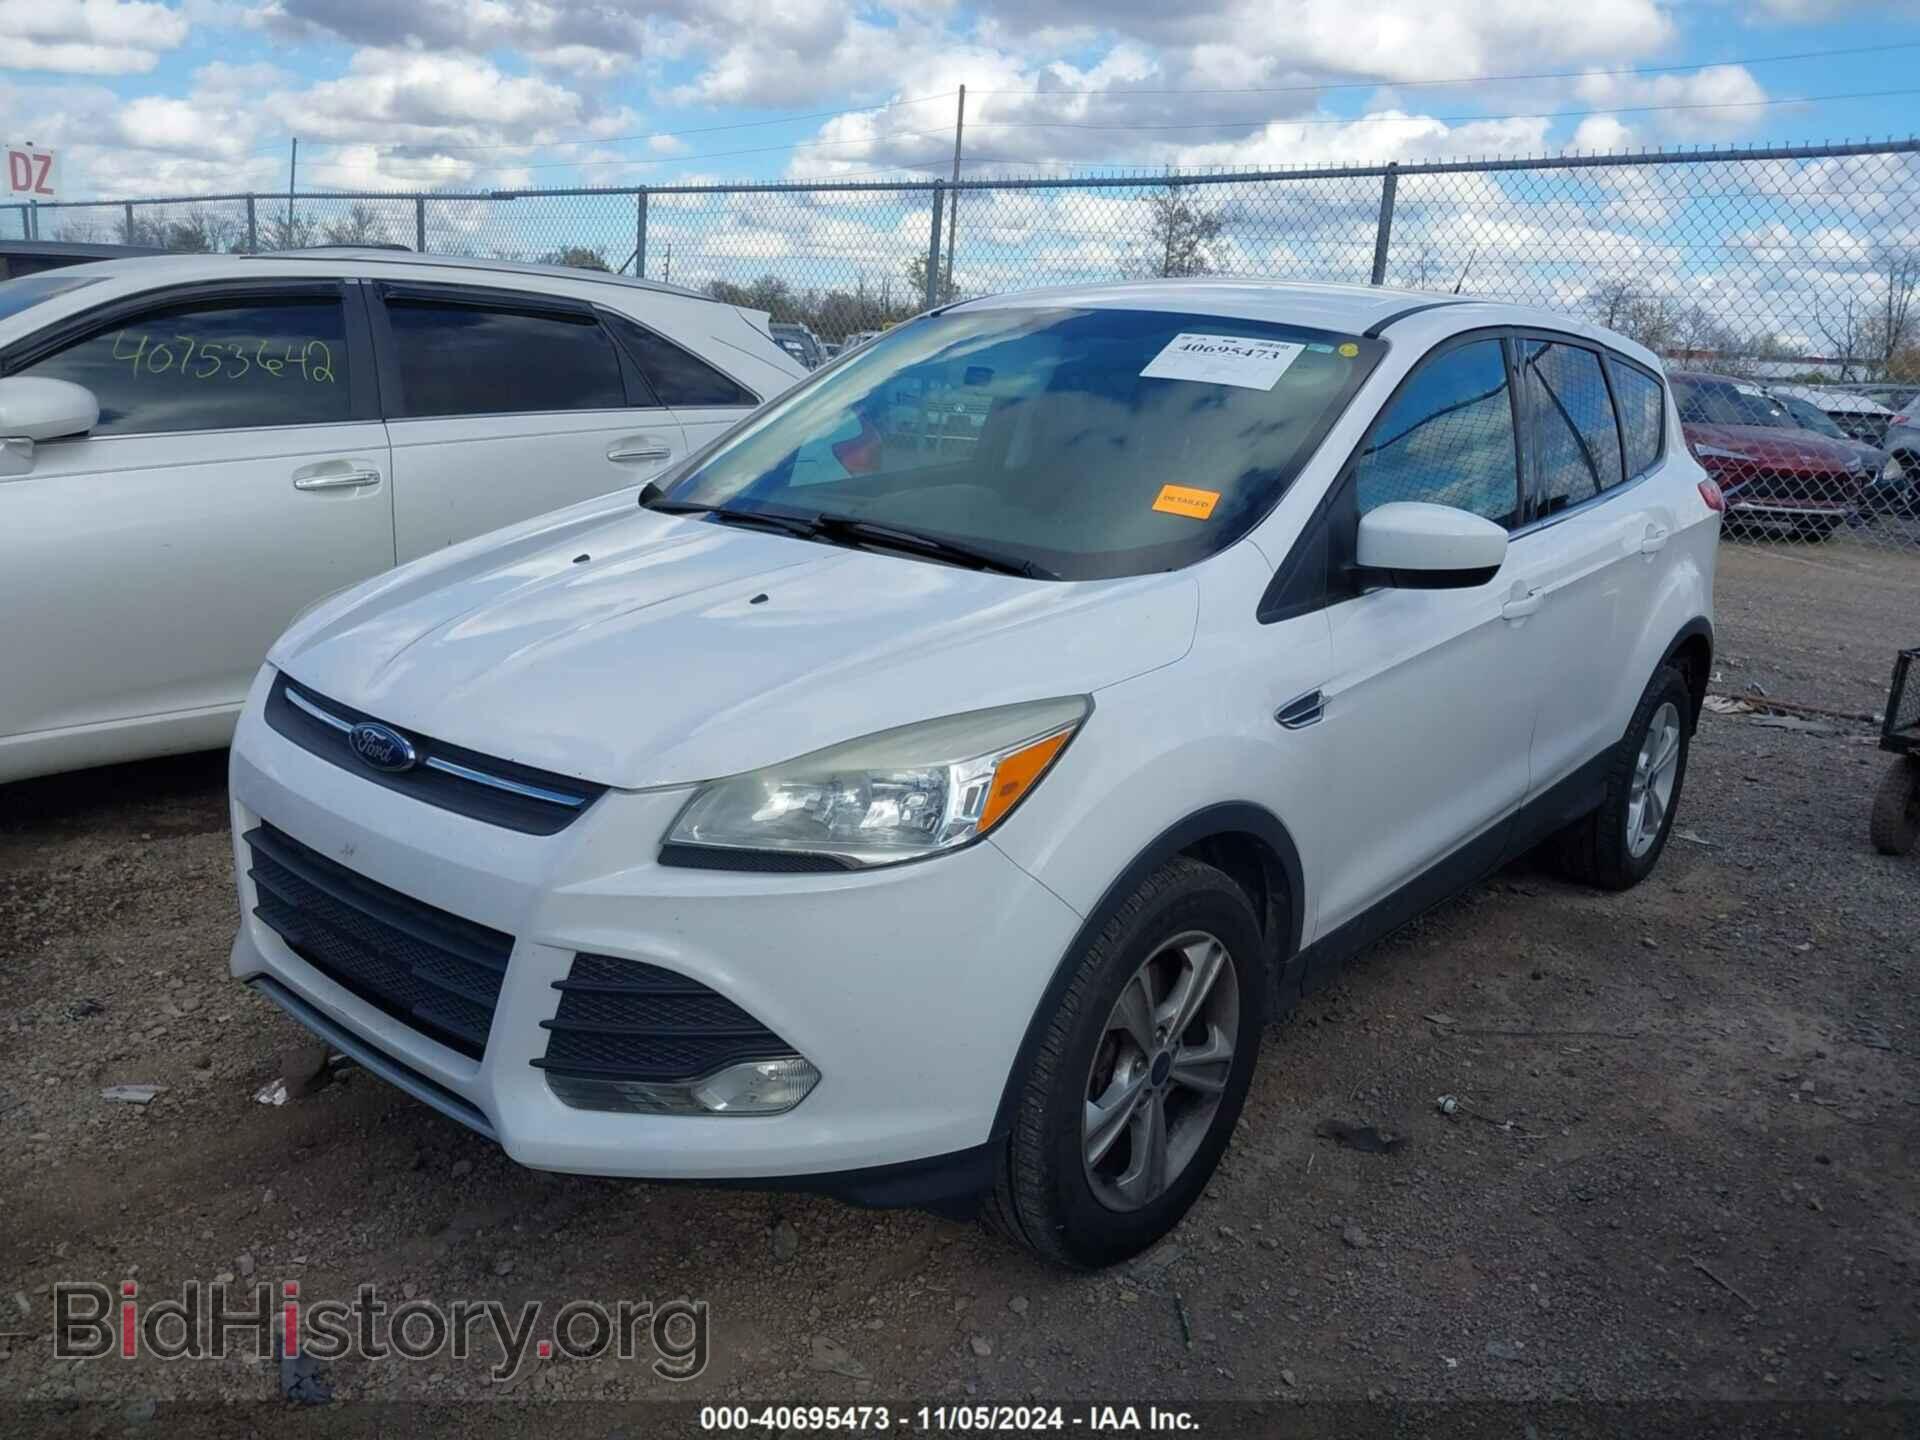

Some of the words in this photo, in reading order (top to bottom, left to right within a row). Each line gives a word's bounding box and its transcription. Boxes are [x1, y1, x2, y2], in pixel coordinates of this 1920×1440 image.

[9, 151, 54, 194] DZ
[112, 330, 334, 383] 40753642
[1179, 343, 1280, 360] 40695473
[1163, 495, 1209, 508] DETAILED
[358, 729, 393, 762] Ford
